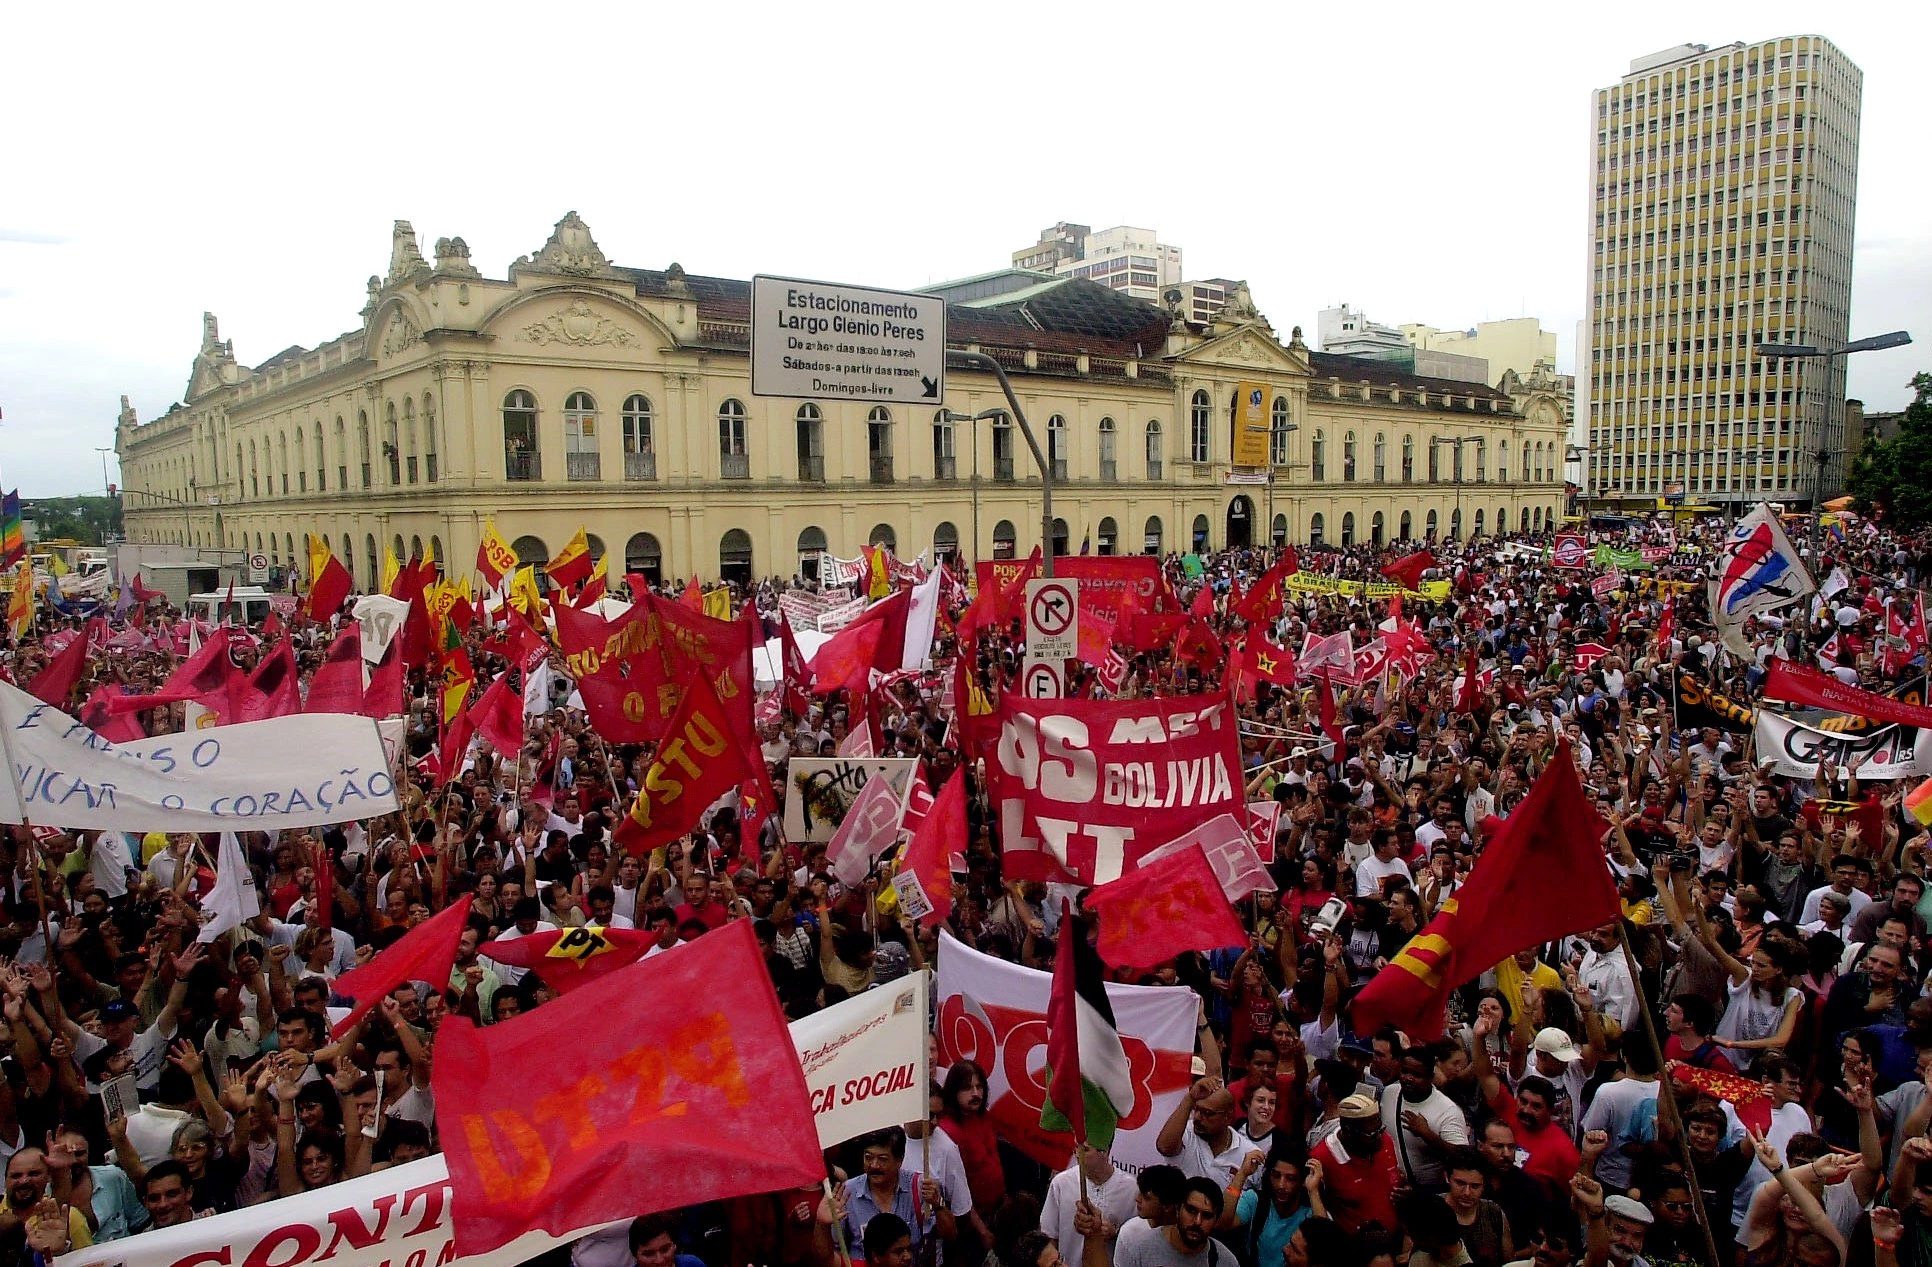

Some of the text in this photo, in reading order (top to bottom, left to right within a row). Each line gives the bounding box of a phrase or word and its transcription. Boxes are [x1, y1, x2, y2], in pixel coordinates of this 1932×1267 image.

[788, 289, 918, 320] Estacionamento
[778, 310, 829, 334] Largo
[883, 321, 925, 341] Peres
[844, 363, 872, 377] partir
[1108, 702, 1226, 744] MST
[210, 767, 394, 816] CORAÇÃO
[1103, 752, 1232, 808] BOLIVIA
[559, 928, 606, 959] PT
[841, 1062, 915, 1106] SOCIAL
